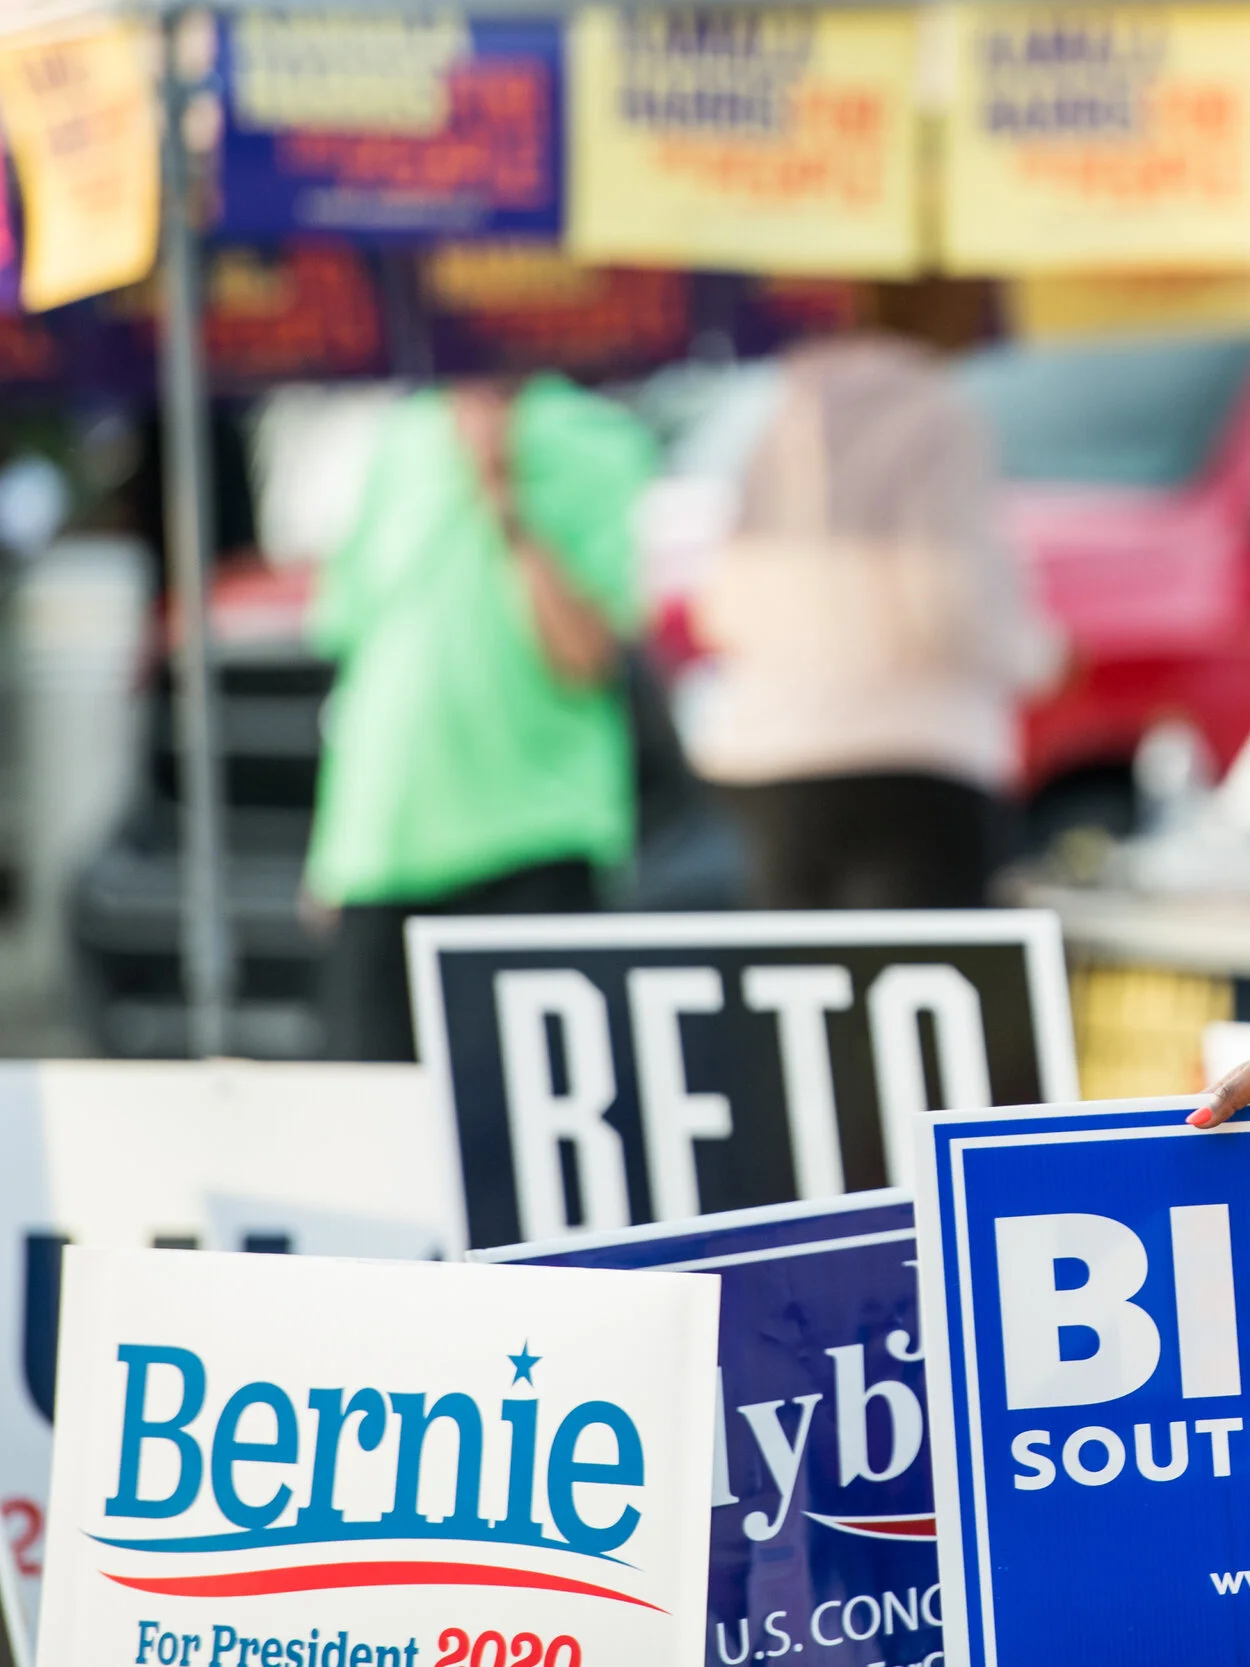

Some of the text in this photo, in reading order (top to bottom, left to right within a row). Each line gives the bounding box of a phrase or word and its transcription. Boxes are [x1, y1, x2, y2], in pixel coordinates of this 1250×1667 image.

[494, 962, 994, 1240] BETO
[104, 1338, 646, 1554] Bernie
[135, 1620, 582, 1667] For President 2020
[716, 1610, 804, 1665] U.S.
